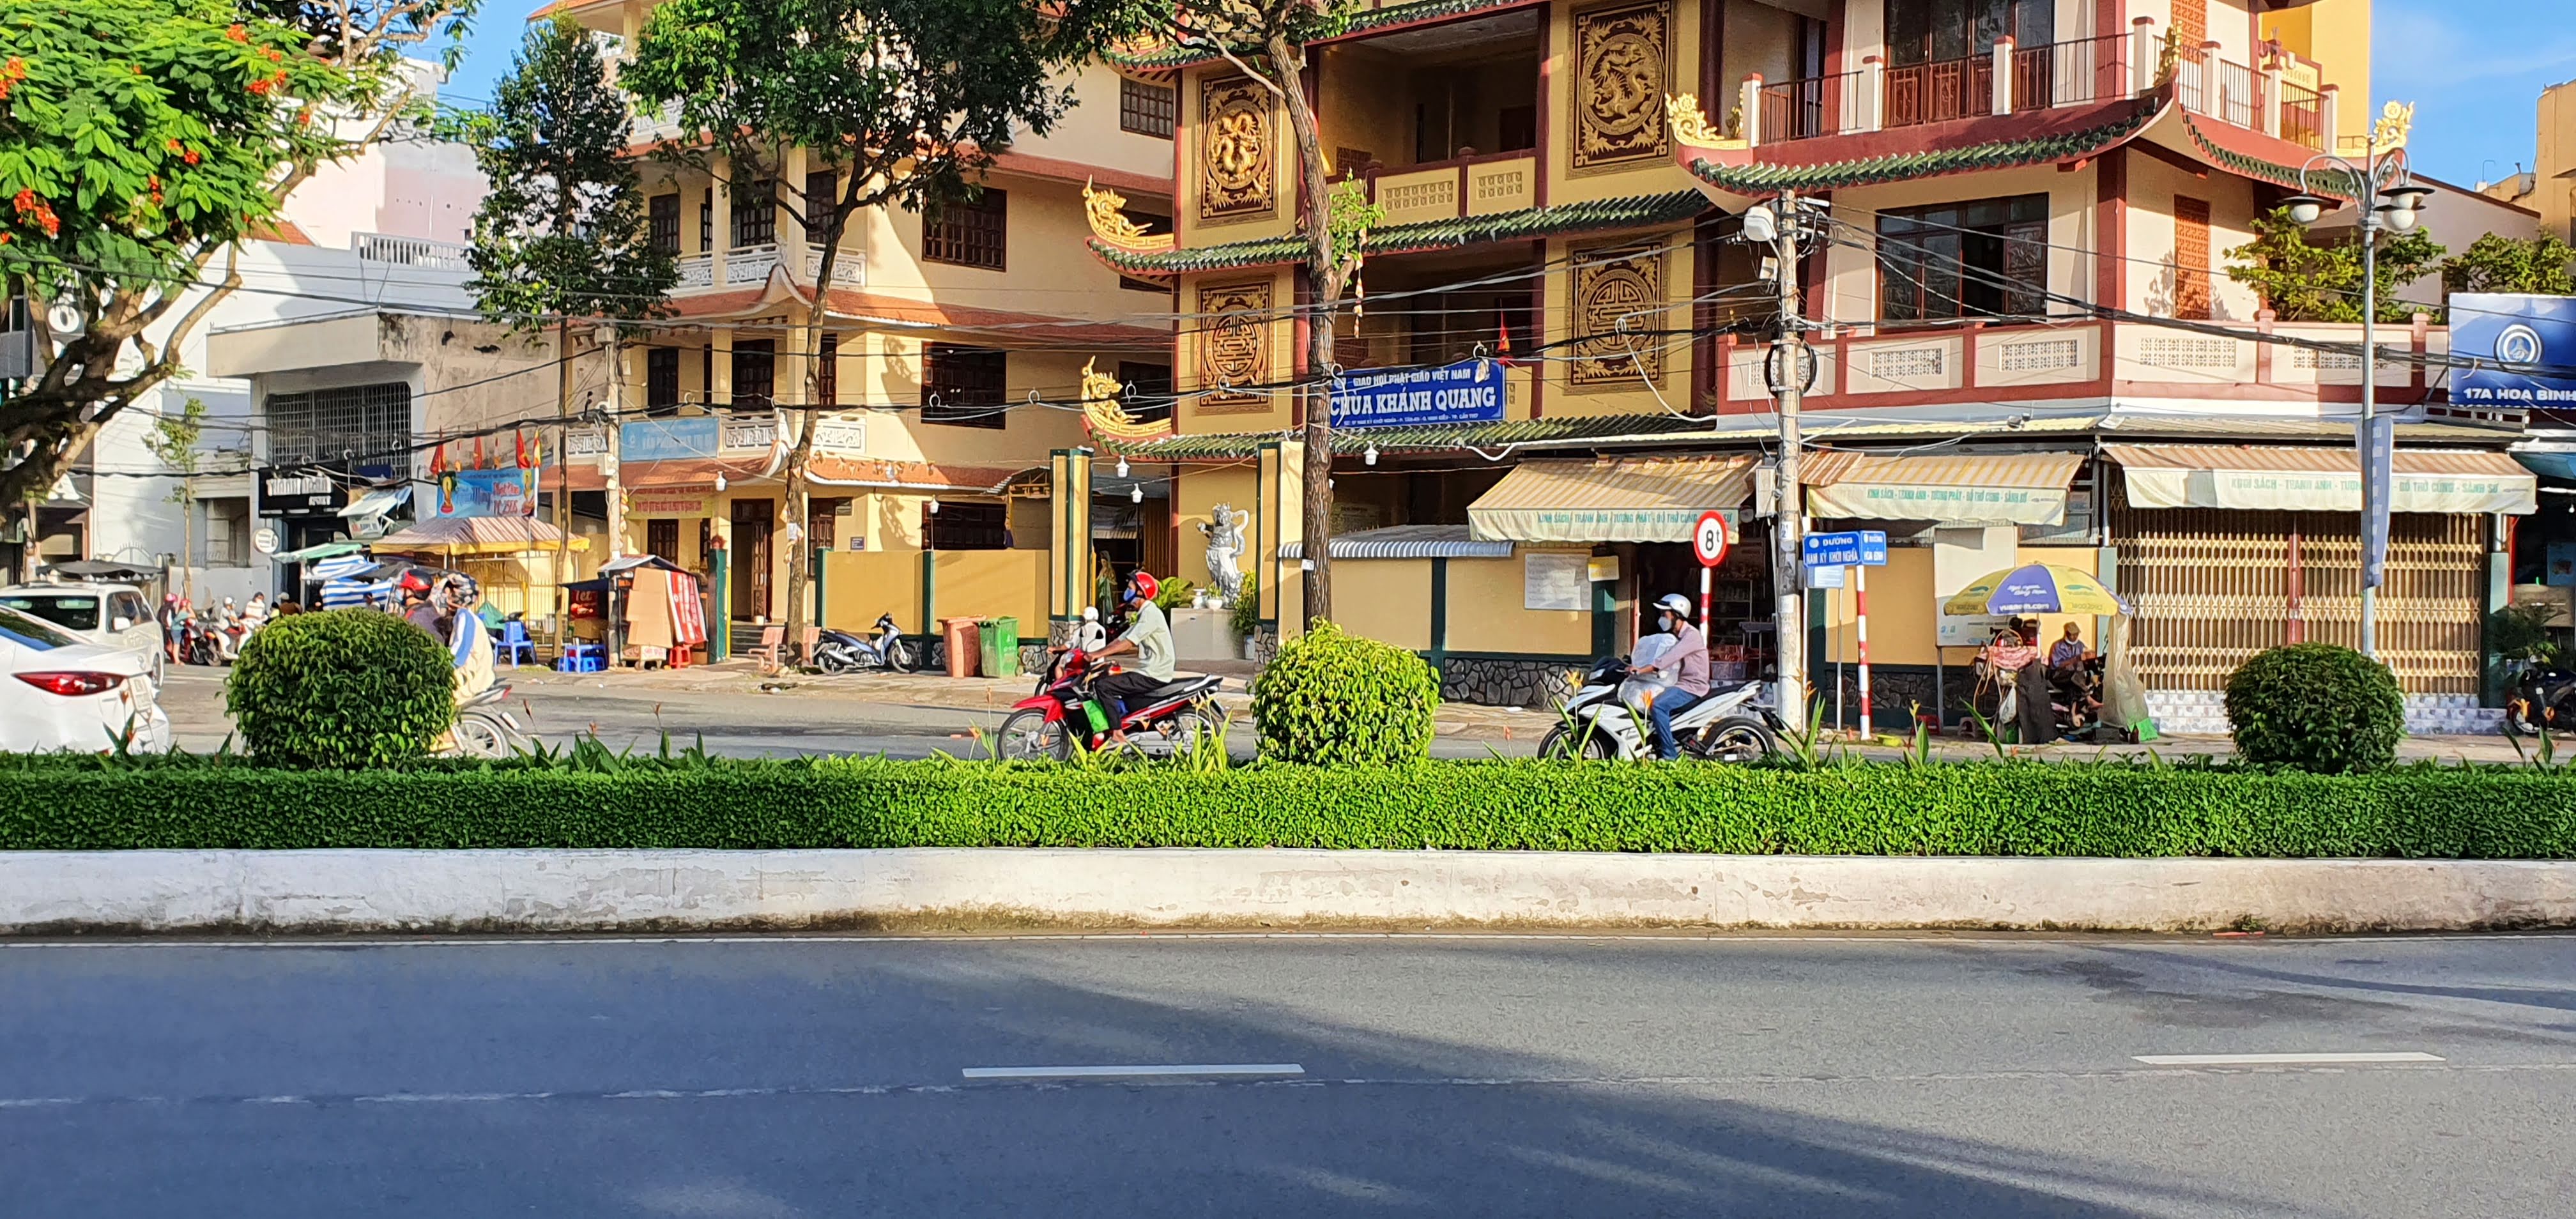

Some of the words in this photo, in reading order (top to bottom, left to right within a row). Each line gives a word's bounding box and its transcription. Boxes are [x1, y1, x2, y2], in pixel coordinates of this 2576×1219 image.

[1432, 367, 1449, 383] VIỆT
[1451, 369, 1471, 379] NAM
[1376, 387, 1432, 414] KHÁNH
[1435, 387, 1496, 411] QUANG
[2464, 388, 2492, 399] 17A
[2497, 388, 2533, 400] HOA
[1822, 535, 1853, 547] ĐƯỜNG
